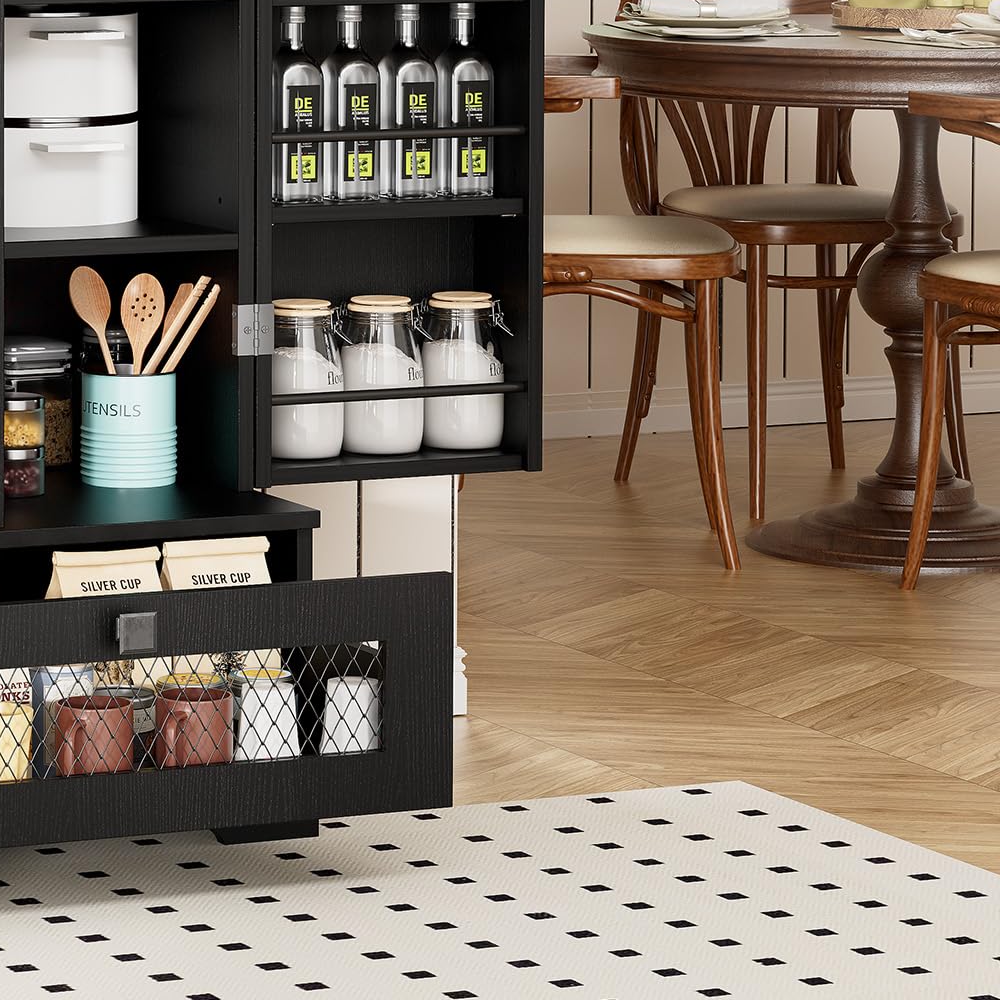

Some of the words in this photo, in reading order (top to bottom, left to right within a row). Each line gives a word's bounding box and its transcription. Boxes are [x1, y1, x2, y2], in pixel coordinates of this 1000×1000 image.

[294, 97, 312, 109] DE
[351, 96, 369, 108] DE
[409, 94, 427, 106] DE
[465, 92, 482, 104] DE
[80, 579, 117, 592] SILVER
[119, 578, 141, 590] CUP
[191, 573, 228, 586] SILVER
[229, 572, 251, 583] CUP
